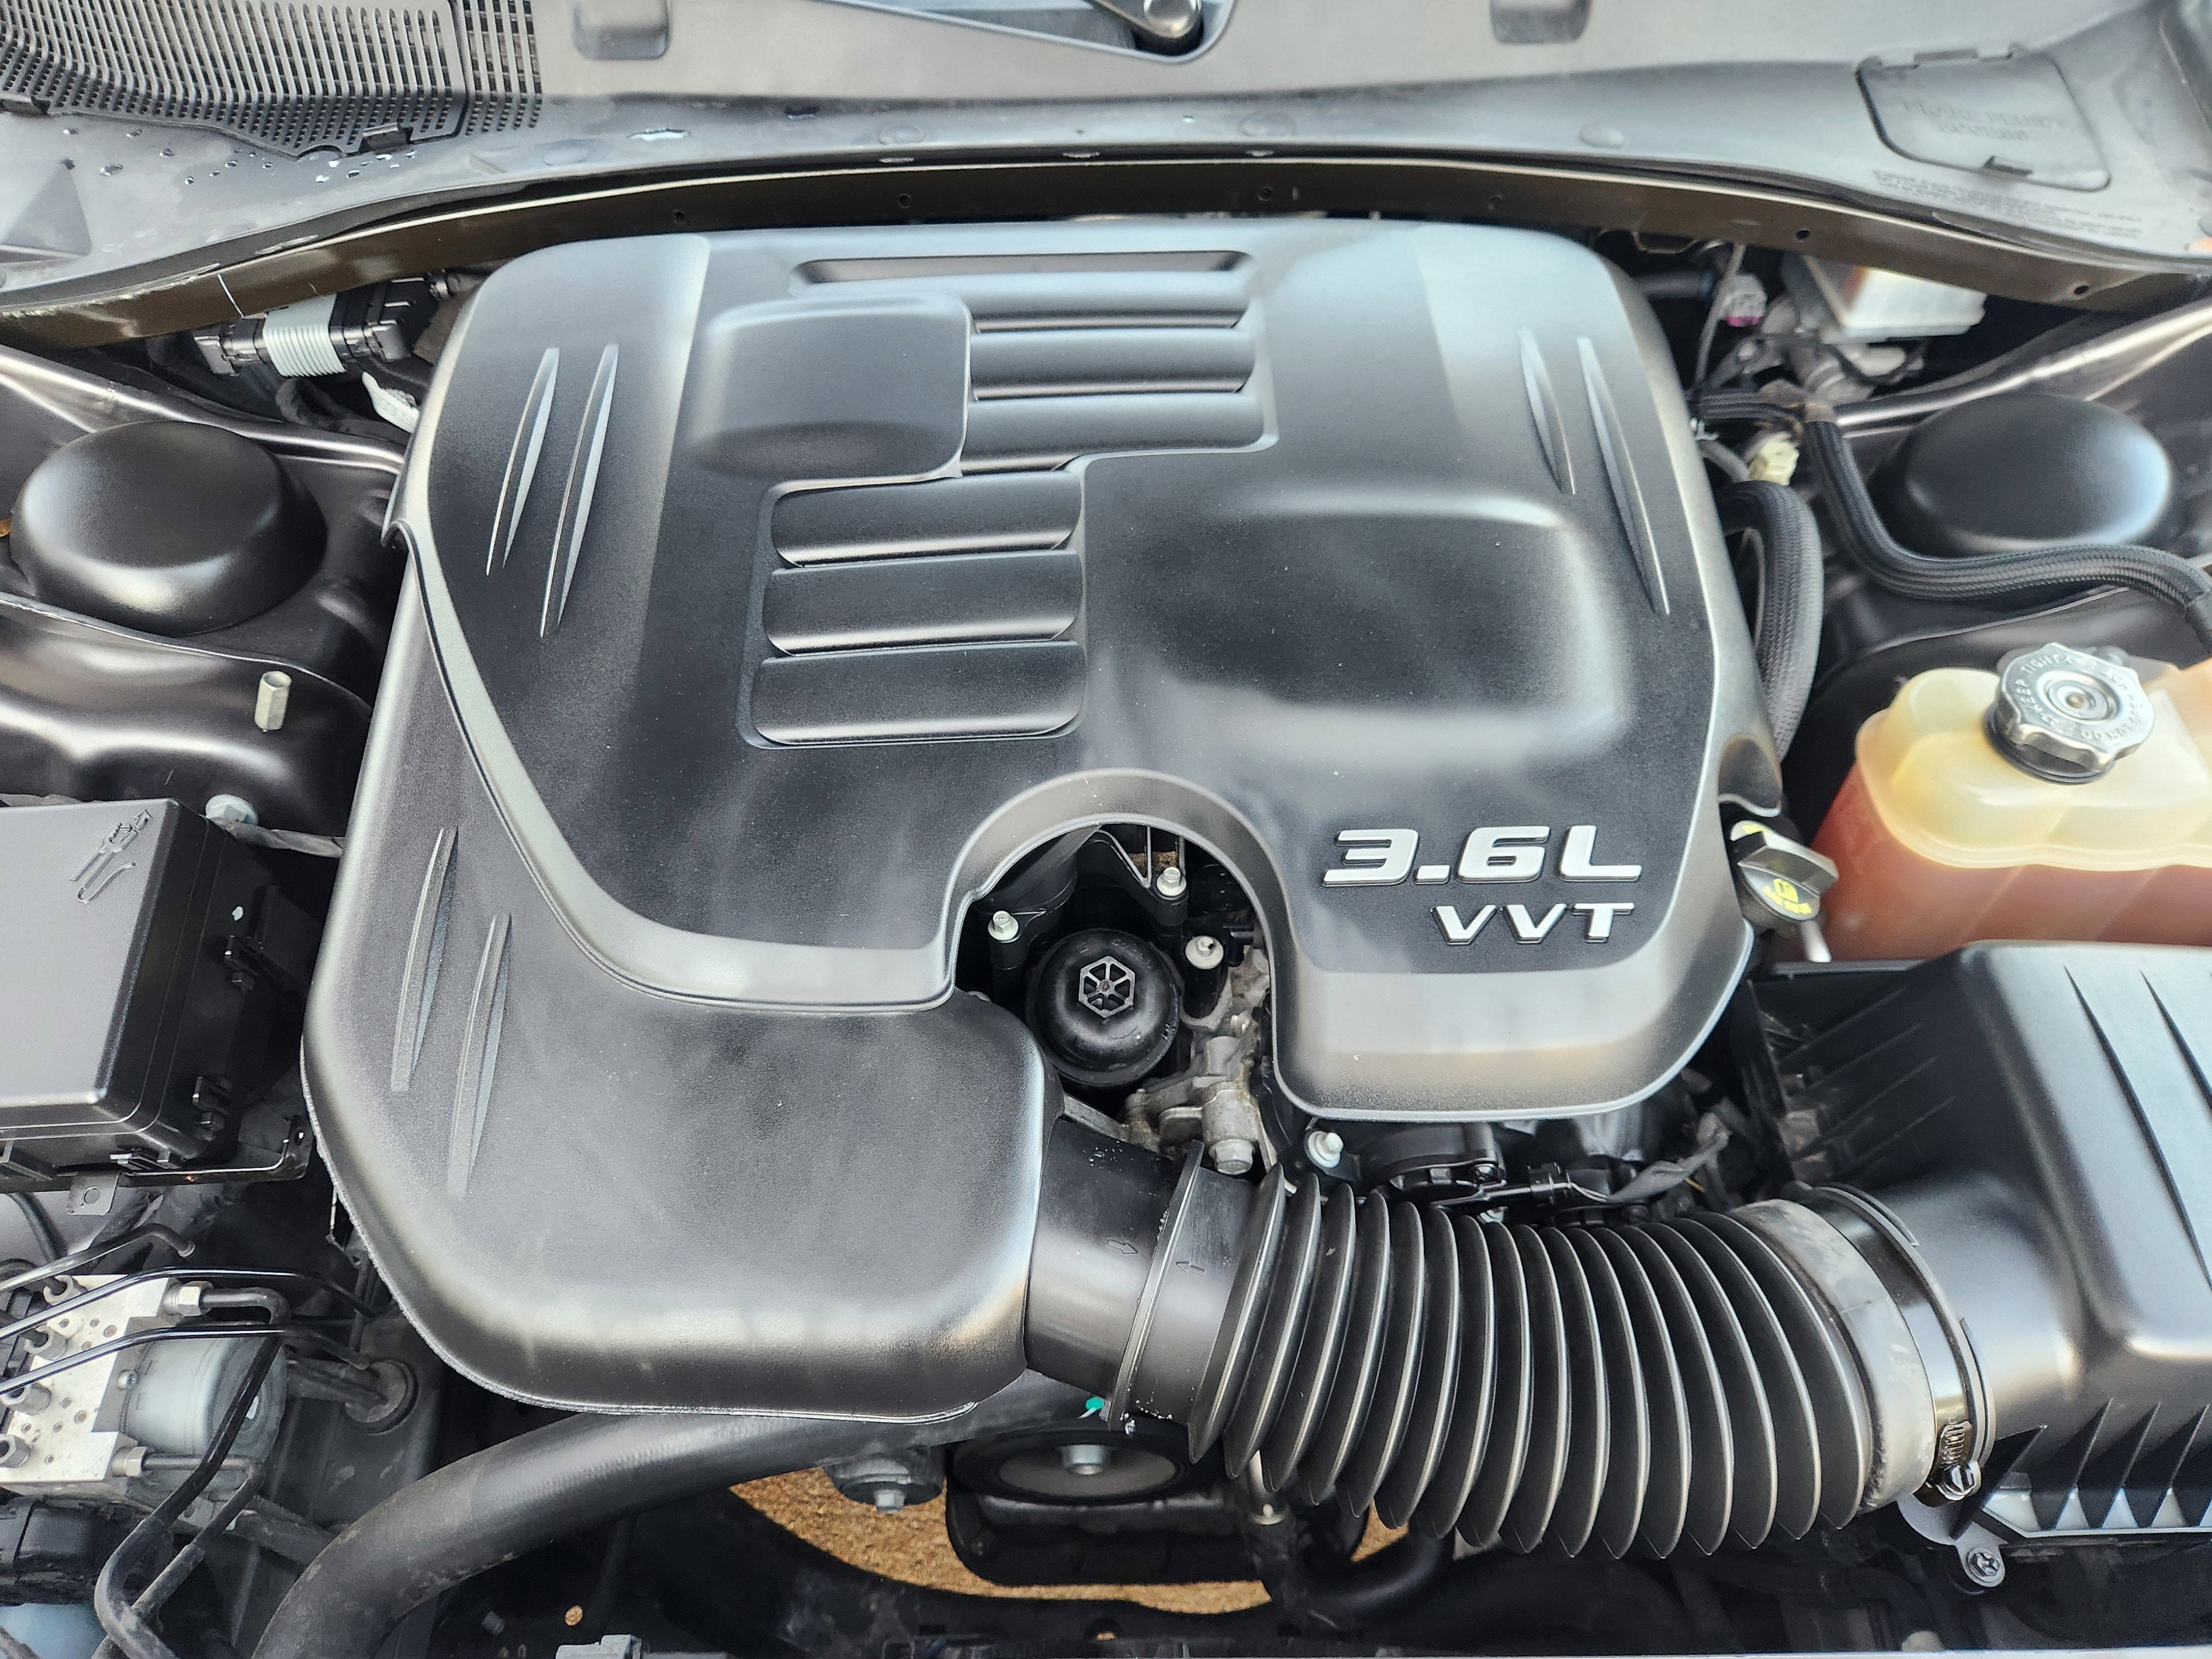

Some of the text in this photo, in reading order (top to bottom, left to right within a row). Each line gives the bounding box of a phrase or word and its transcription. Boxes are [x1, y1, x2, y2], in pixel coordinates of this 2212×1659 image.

[2015, 654, 2060, 713] KEEP TIGHT
[2081, 731, 2104, 740] DO
[2106, 724, 2133, 740] NOT
[1323, 825, 1642, 886] 3.6L
[1430, 902, 1635, 945] VVT
